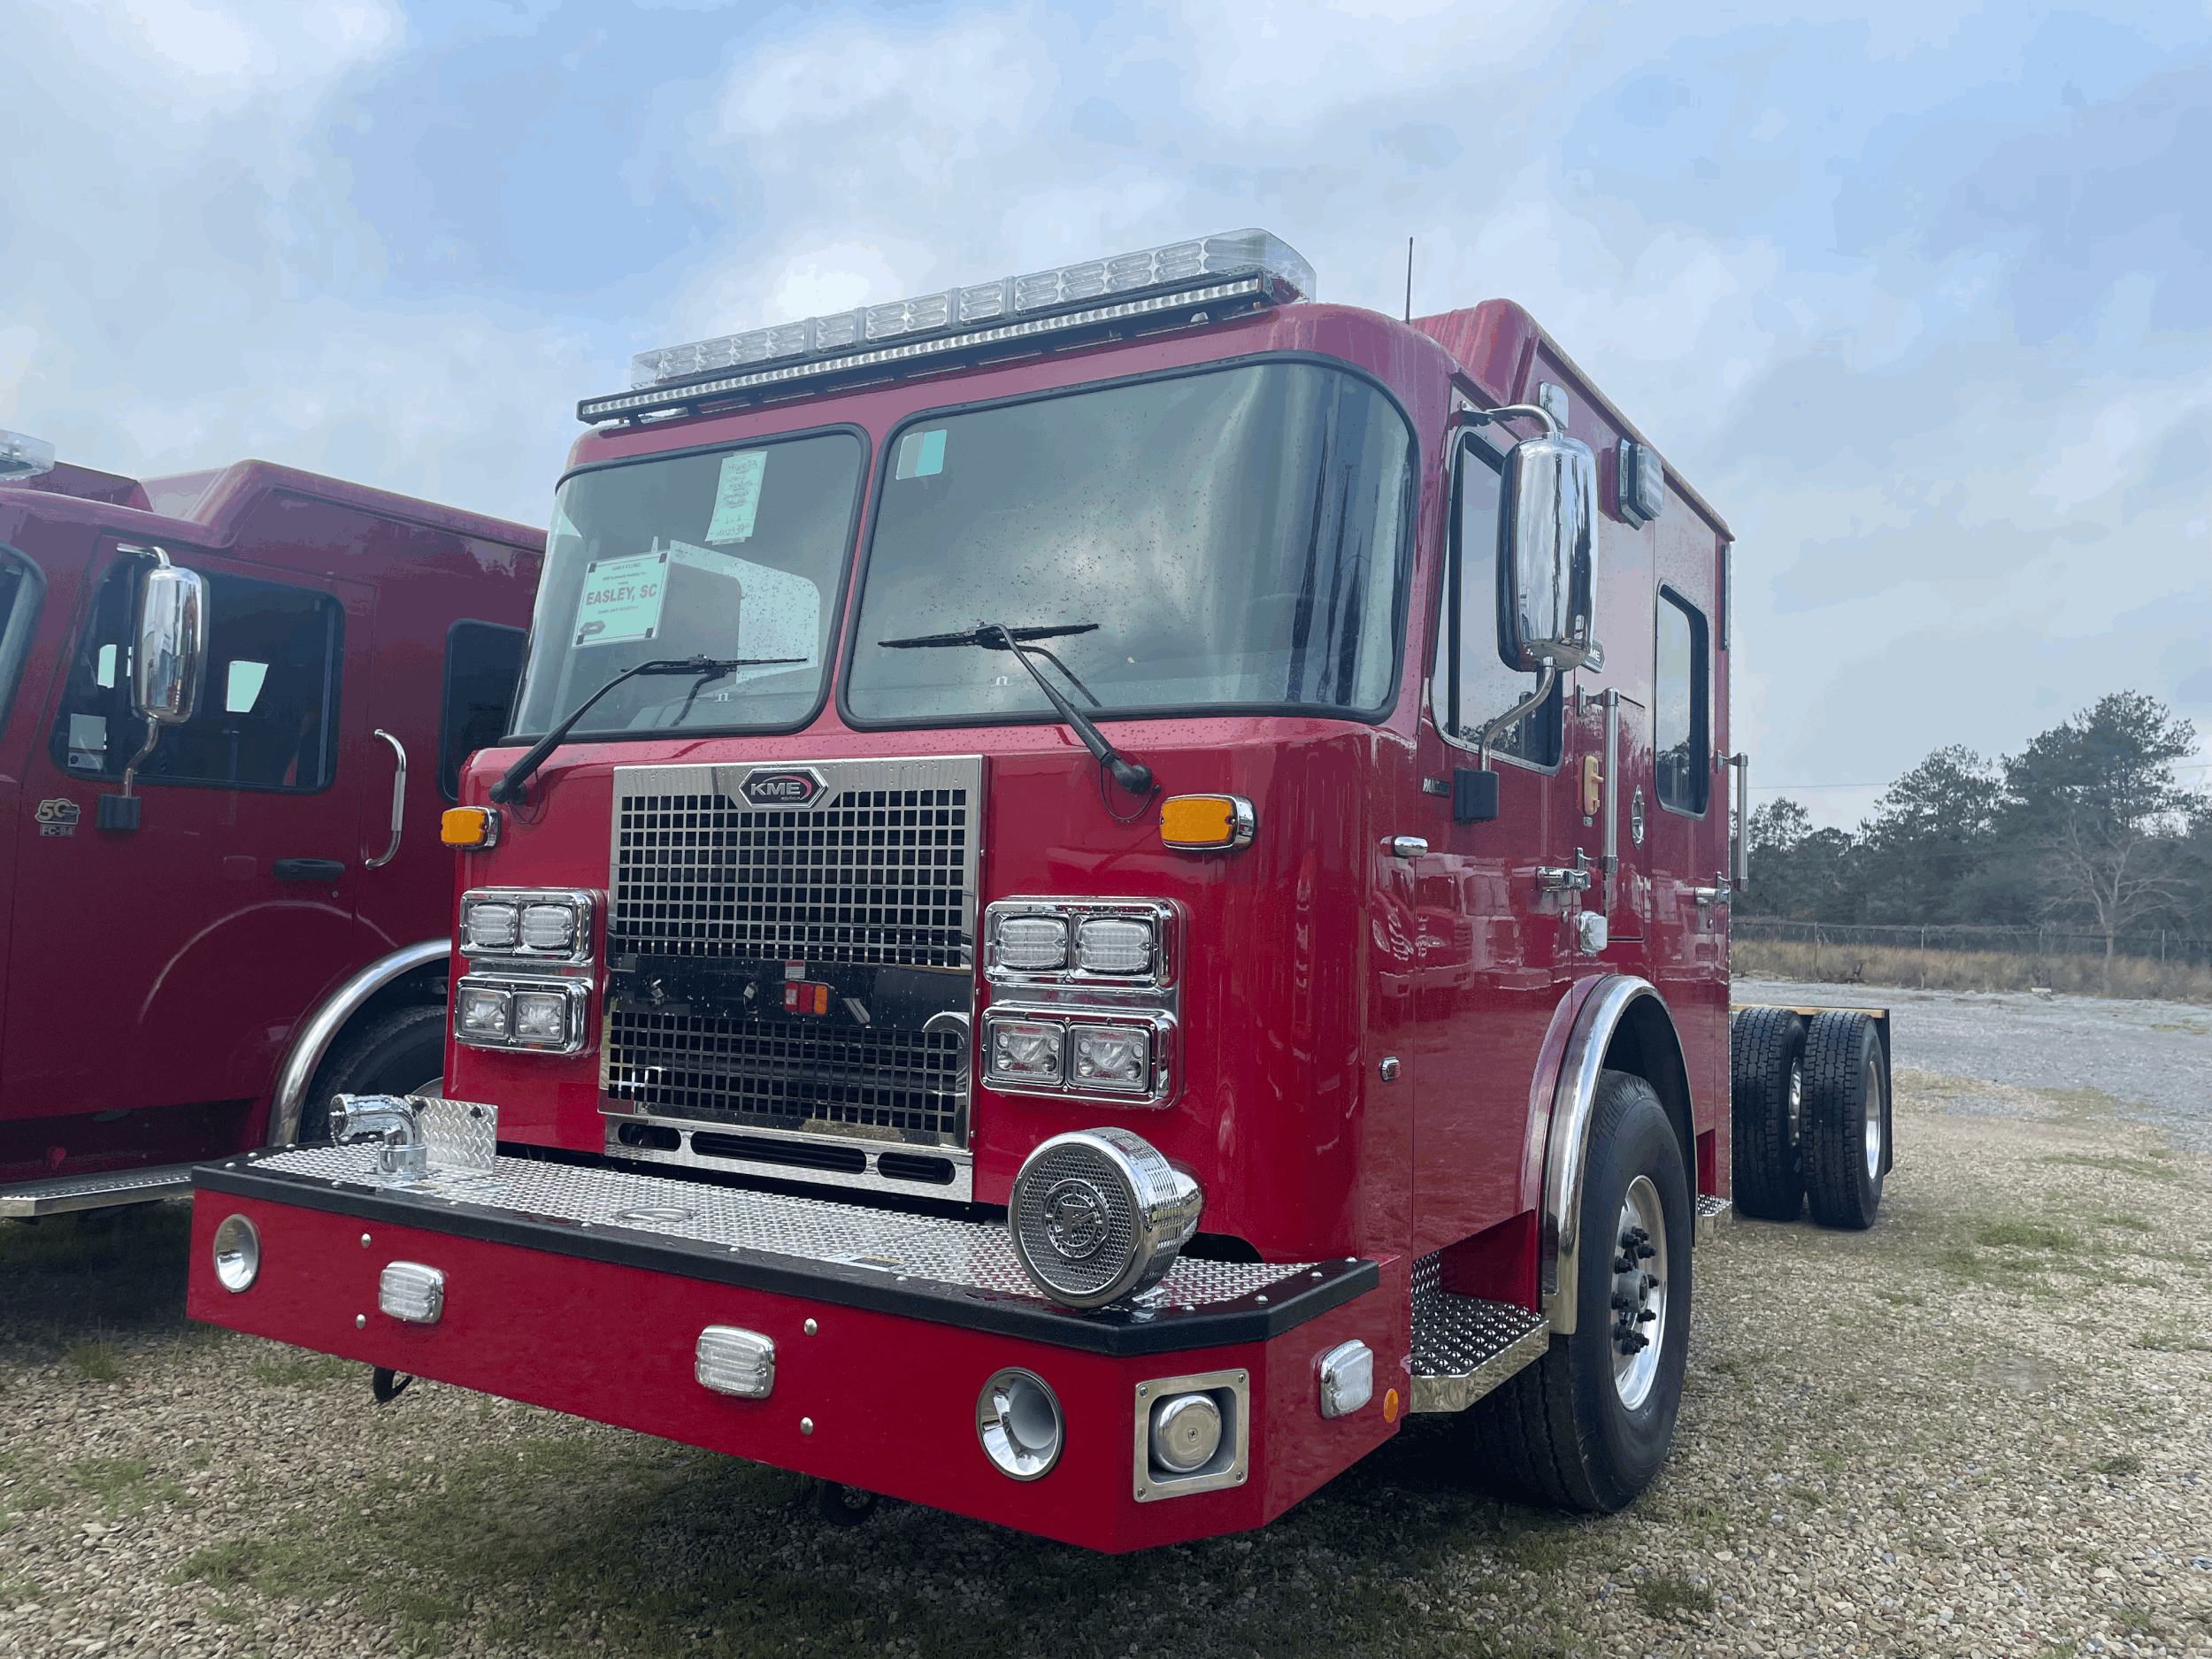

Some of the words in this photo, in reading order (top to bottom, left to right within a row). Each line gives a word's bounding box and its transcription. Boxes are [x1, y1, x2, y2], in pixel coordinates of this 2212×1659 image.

[585, 586, 635, 606] EASLEY,
[639, 583, 657, 599] SC
[750, 782, 801, 795] KME
